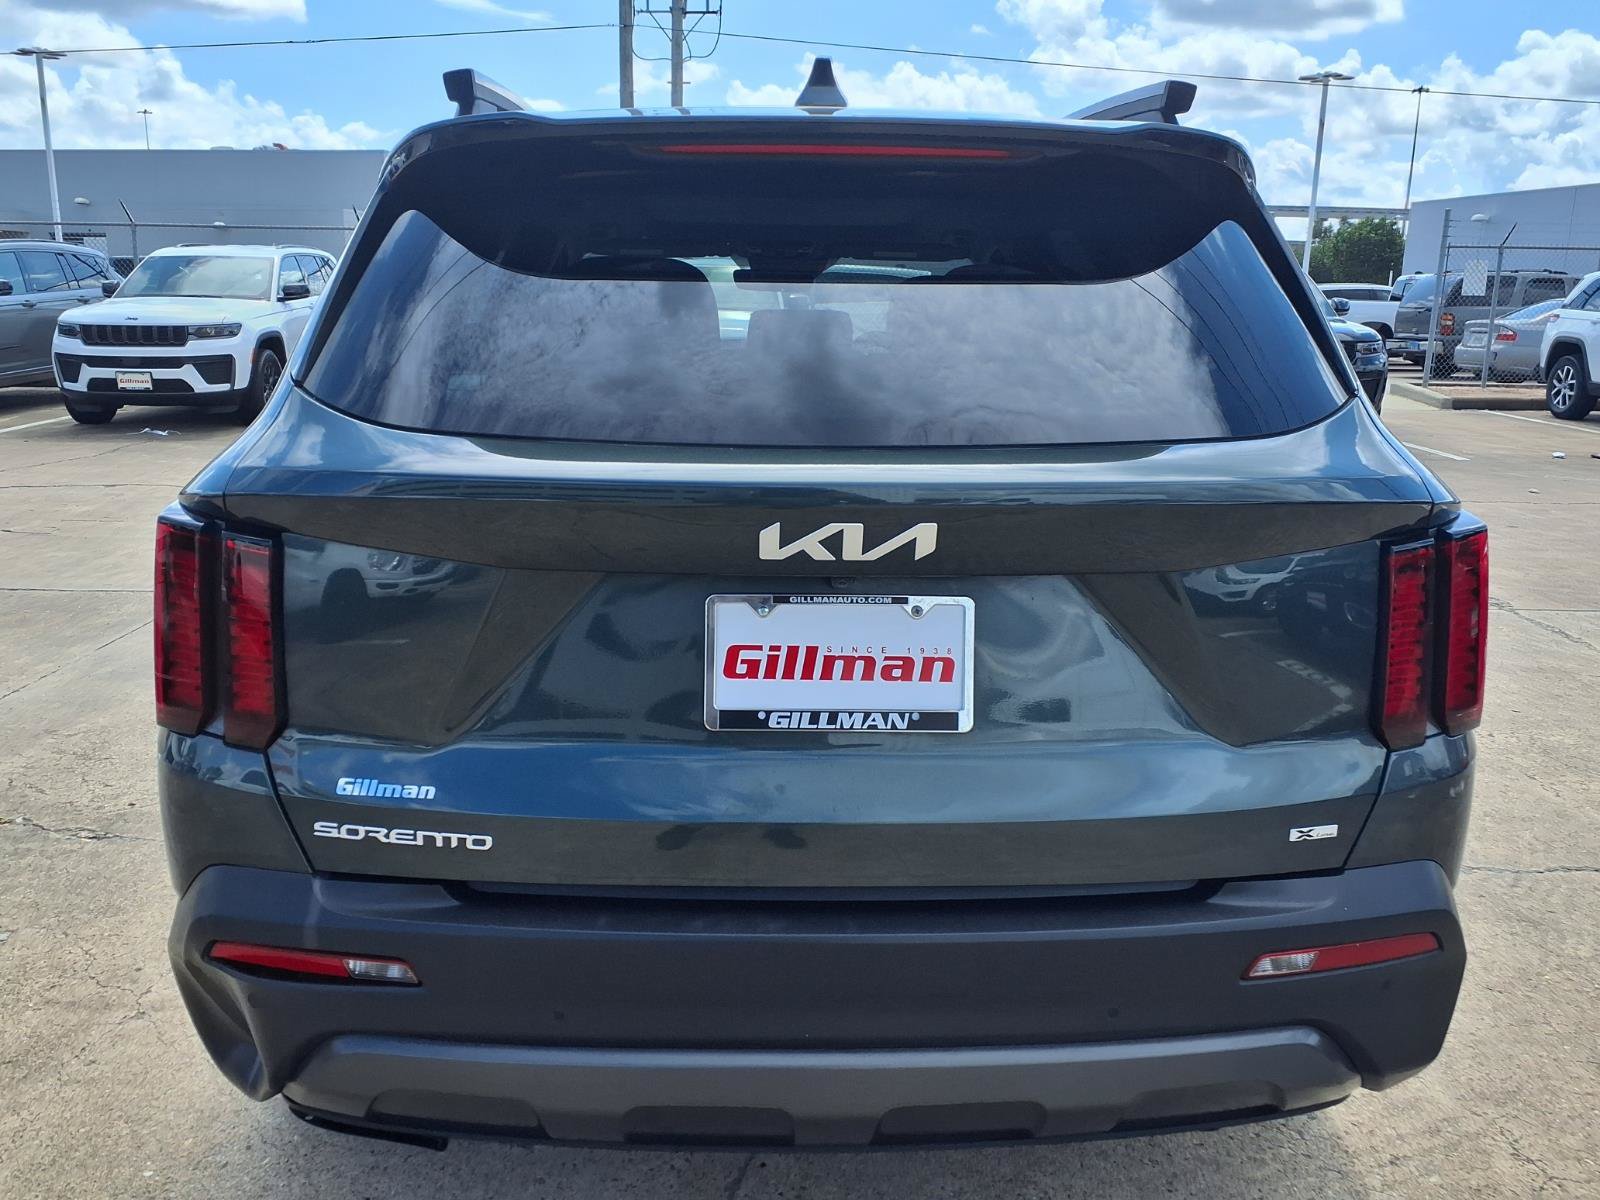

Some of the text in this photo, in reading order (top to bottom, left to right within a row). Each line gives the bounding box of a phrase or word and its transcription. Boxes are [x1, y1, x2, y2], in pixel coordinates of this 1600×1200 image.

[759, 522, 938, 561] KIA
[789, 595, 892, 604] GILLMANAUTO.COM
[826, 646, 952, 655] SINCE 1938
[722, 644, 956, 683] Gillman
[768, 711, 911, 730] GILLMAN
[336, 777, 436, 799] Gillman
[313, 821, 493, 850] SORENTO
